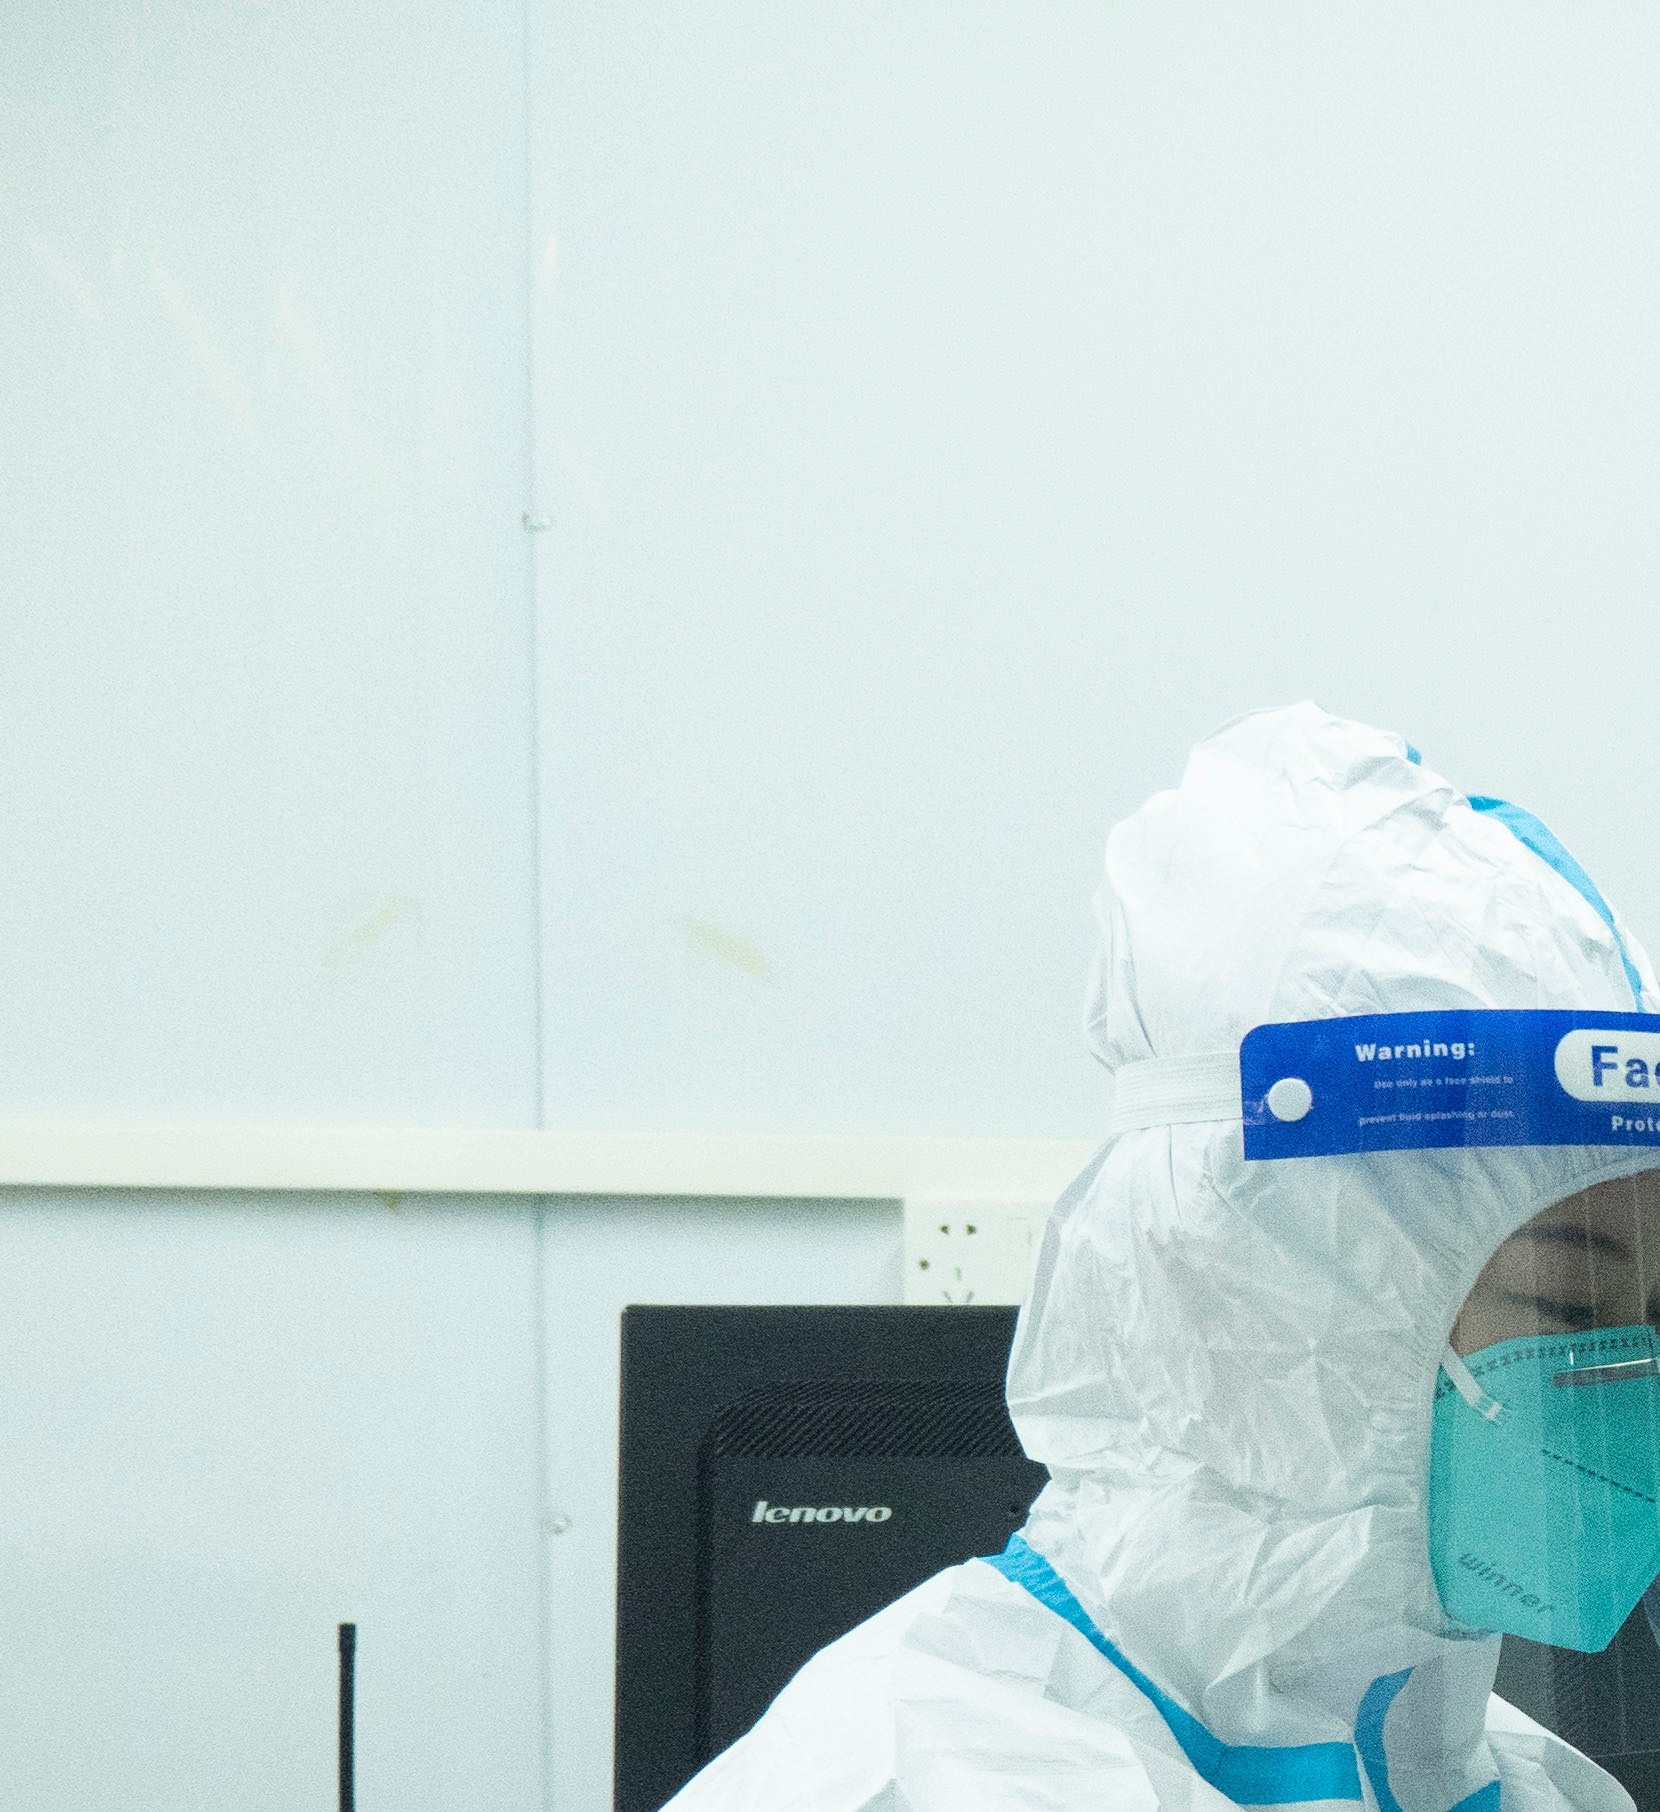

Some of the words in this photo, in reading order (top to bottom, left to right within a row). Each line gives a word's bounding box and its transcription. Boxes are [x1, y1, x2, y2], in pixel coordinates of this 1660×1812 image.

[1355, 1039, 1475, 1063] Warning:
[751, 1500, 893, 1523] lenovo
[1458, 1552, 1556, 1614] winner
